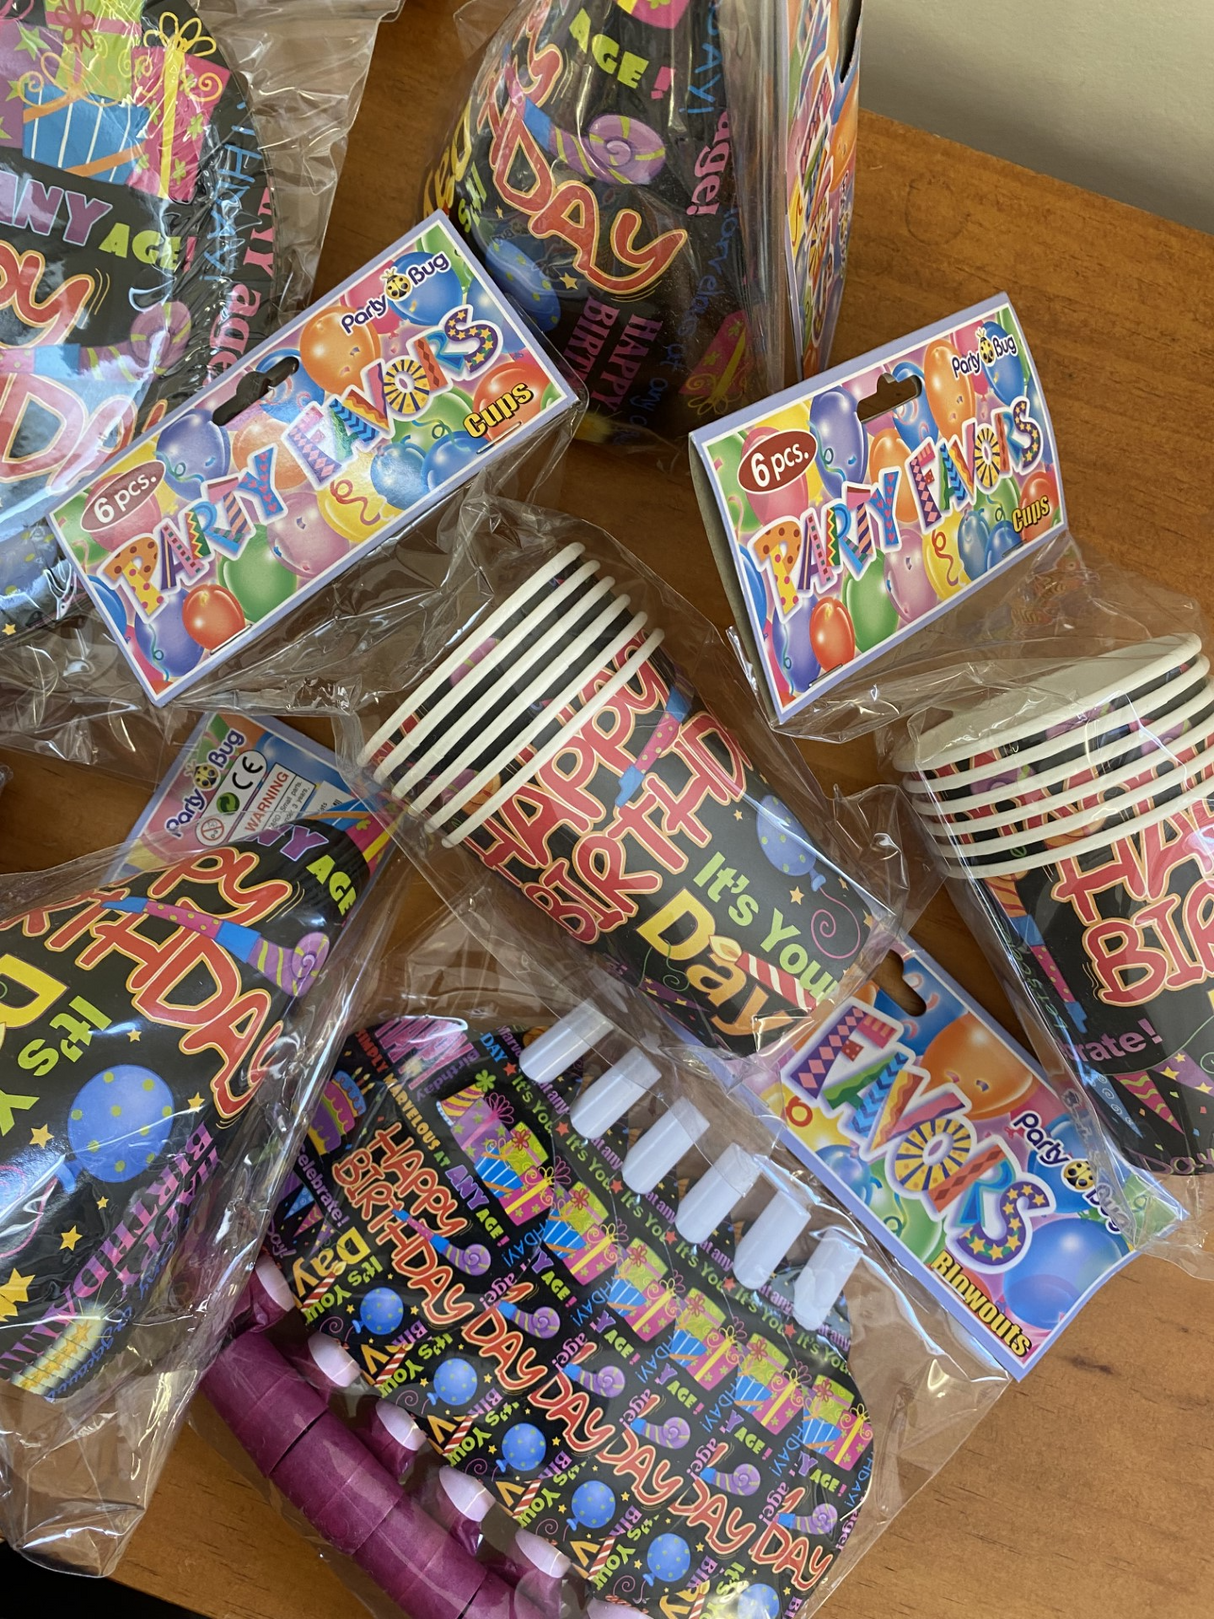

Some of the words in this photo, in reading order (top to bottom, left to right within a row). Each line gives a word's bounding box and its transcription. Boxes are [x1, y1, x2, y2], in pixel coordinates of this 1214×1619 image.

[341, 297, 387, 334] Party
[408, 251, 451, 285] Bug
[951, 353, 982, 379] Party
[992, 333, 1019, 359] Bug
[463, 383, 534, 438] Cups
[97, 444, 288, 623] PARTY
[281, 305, 503, 490] FAVORS
[750, 451, 772, 487] 6
[771, 442, 812, 475] pcs.
[93, 494, 116, 523] 6
[112, 474, 158, 511] pcs.
[748, 466, 901, 624] PARTY
[905, 396, 1044, 534] FAVORS
[1011, 494, 1051, 533] Cups
[164, 787, 208, 839] Party
[207, 728, 247, 769] Bug
[244, 770, 290, 834] WARNING
[692, 850, 760, 928] It's
[18, 995, 113, 1077] It's
[511, 1074, 532, 1103] It's
[531, 1100, 554, 1137] You
[779, 997, 1057, 1275] FAVORS
[382, 1072, 442, 1151] MARVELOUS
[444, 1164, 490, 1212] ANY
[565, 1134, 588, 1163] It's
[588, 1157, 612, 1193] You
[1013, 1110, 1069, 1166] Party
[365, 1121, 474, 1238] HAPPY
[620, 1190, 644, 1219] It's
[642, 1215, 667, 1246] You
[346, 1254, 384, 1288] It's
[675, 1241, 700, 1268] It's
[699, 1262, 724, 1292] You
[734, 1288, 759, 1315] It's
[761, 1308, 786, 1337] You
[930, 1249, 1034, 1357] Blowouts
